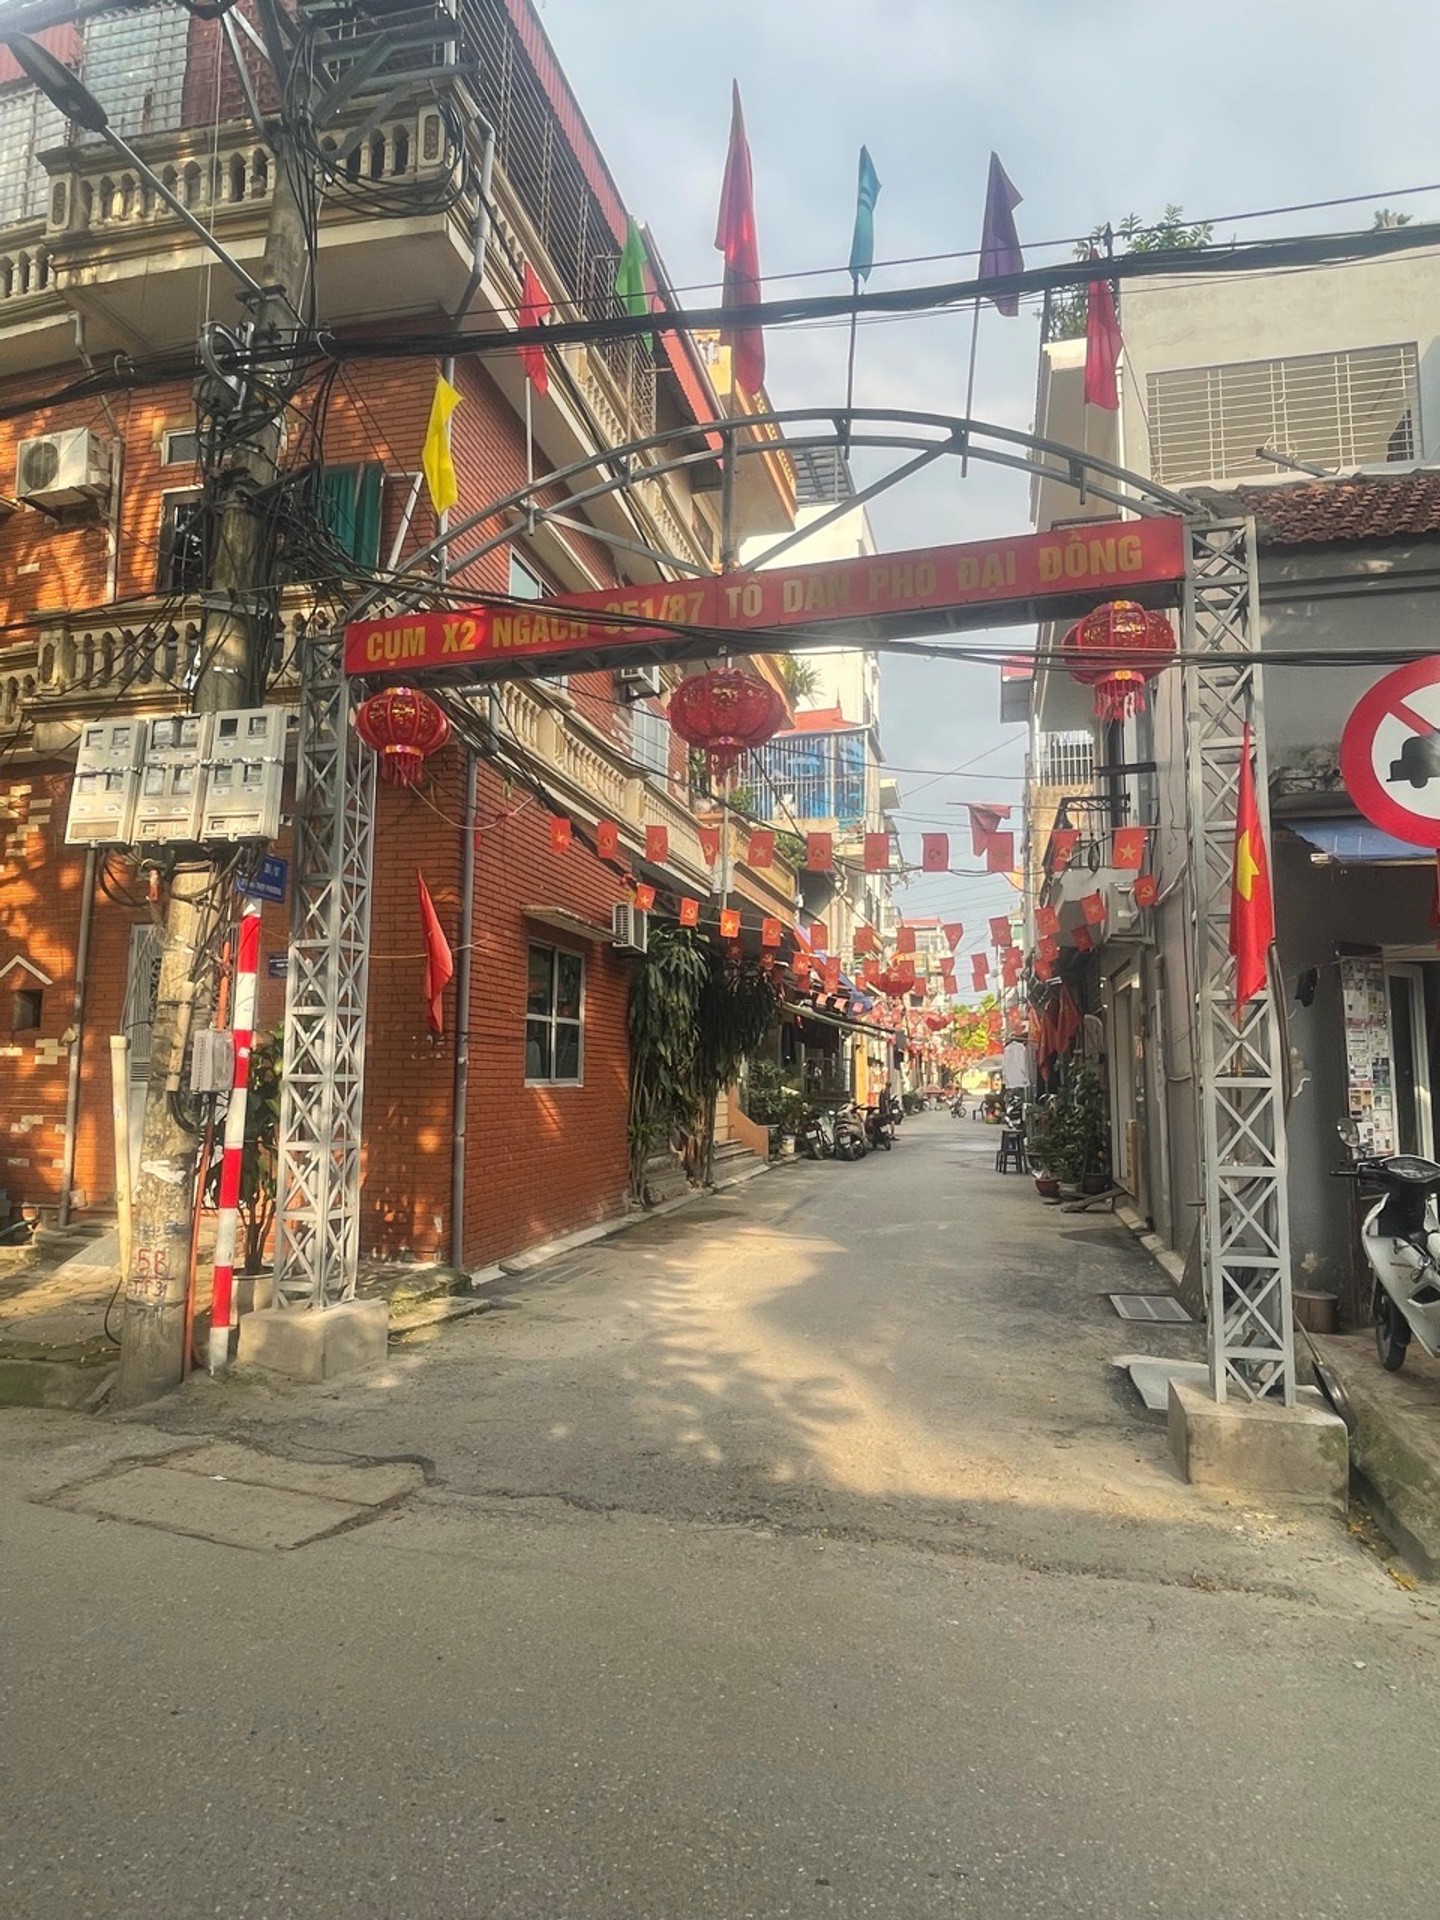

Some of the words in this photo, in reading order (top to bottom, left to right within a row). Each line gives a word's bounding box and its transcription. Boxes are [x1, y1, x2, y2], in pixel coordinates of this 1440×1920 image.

[367, 626, 426, 667] CỤM
[442, 620, 477, 654] X2
[957, 551, 1017, 594] ĐẠI
